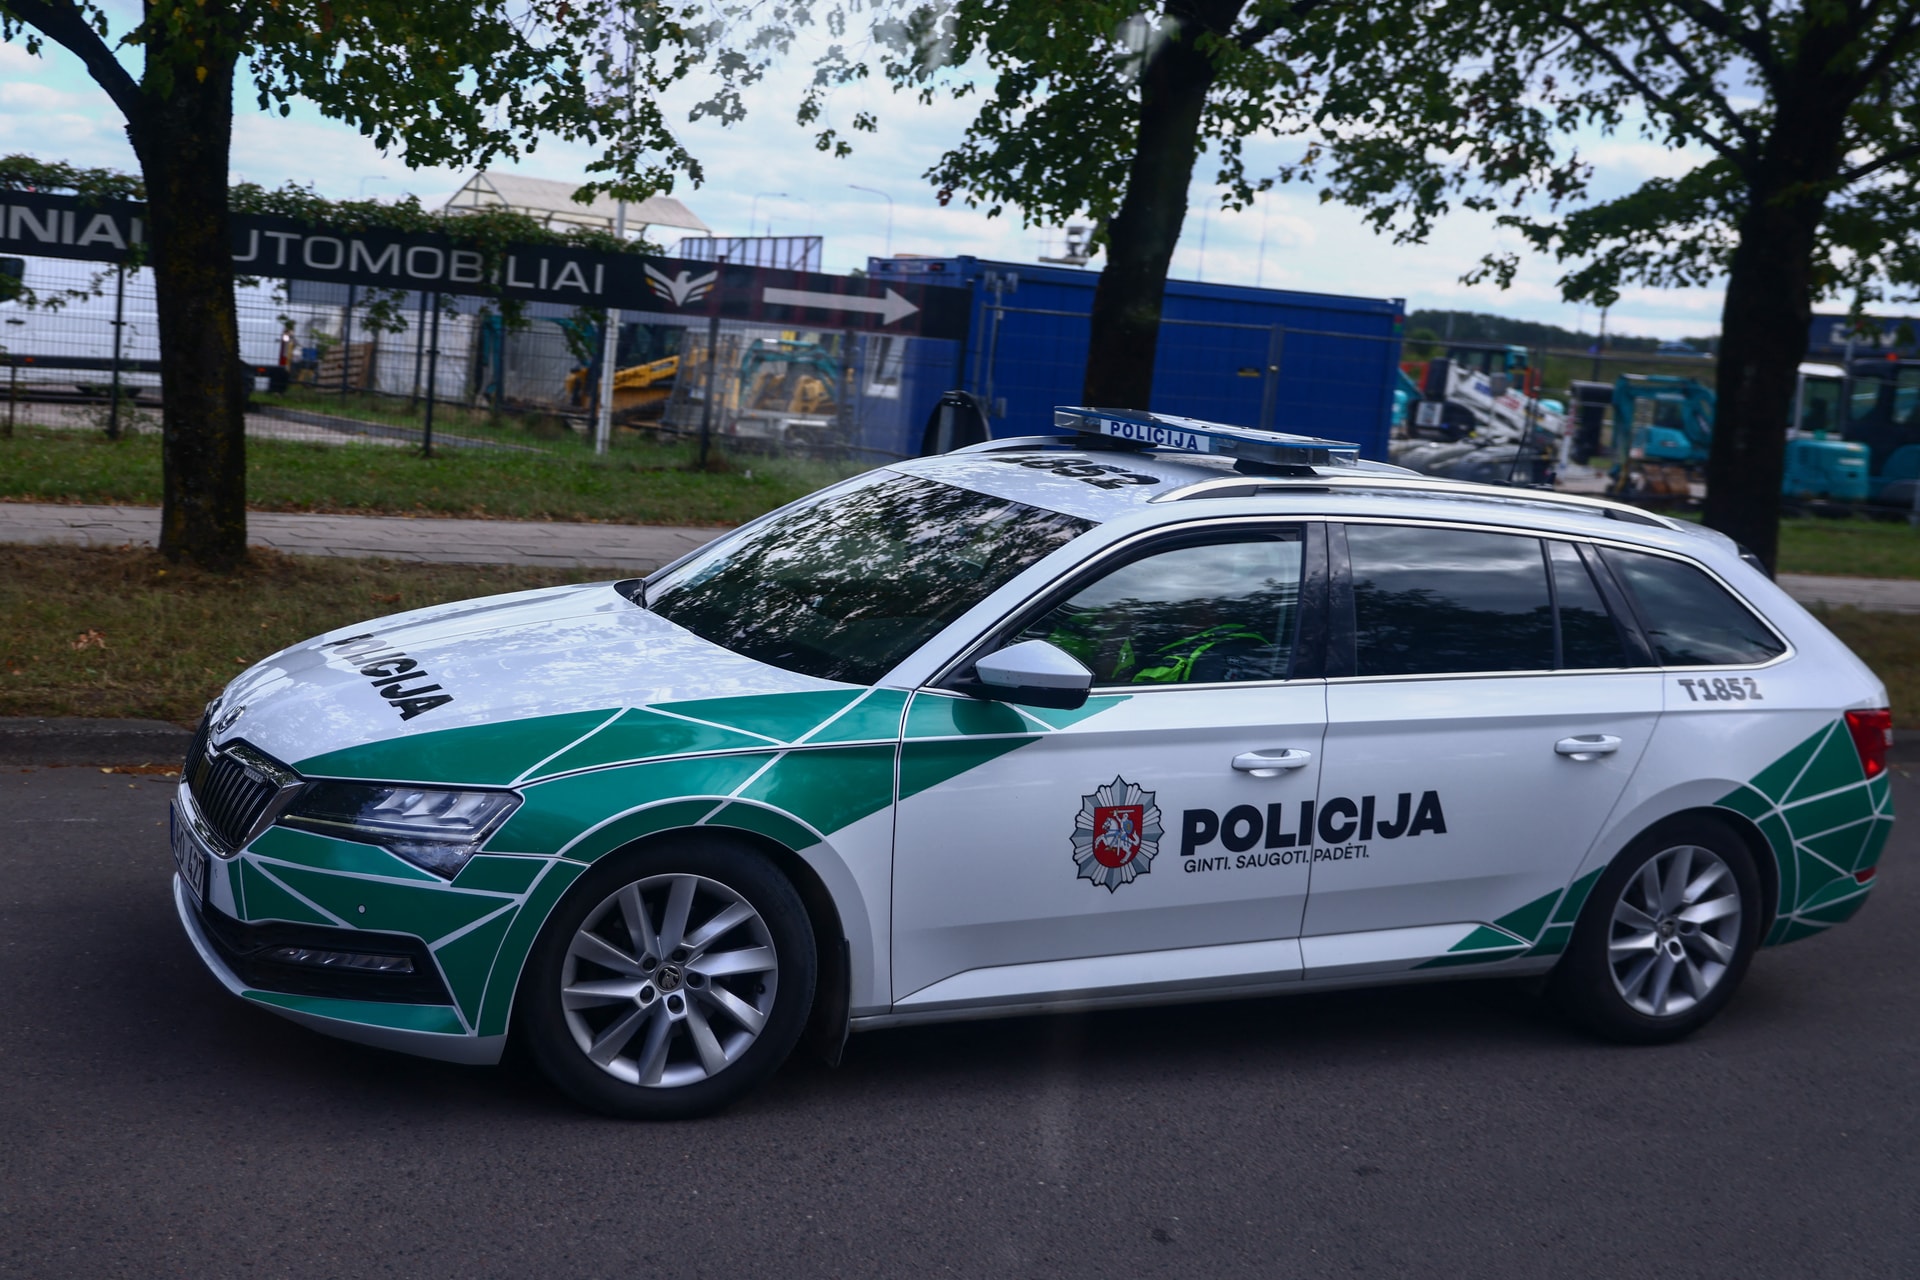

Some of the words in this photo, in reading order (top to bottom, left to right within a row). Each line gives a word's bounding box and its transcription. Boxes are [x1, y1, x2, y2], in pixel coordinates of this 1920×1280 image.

[231, 228, 605, 295] UTOMOBILIAI
[1110, 421, 1199, 451] POLICIJA
[321, 633, 454, 721] POLICIJA
[1678, 677, 1764, 701] T1852
[1180, 790, 1447, 857] POLICIJA
[187, 845, 204, 892] 427
[1183, 856, 1231, 873] GINTI.
[1236, 849, 1310, 870] SAUGOTI.
[1313, 842, 1370, 863] PADĖTI.
